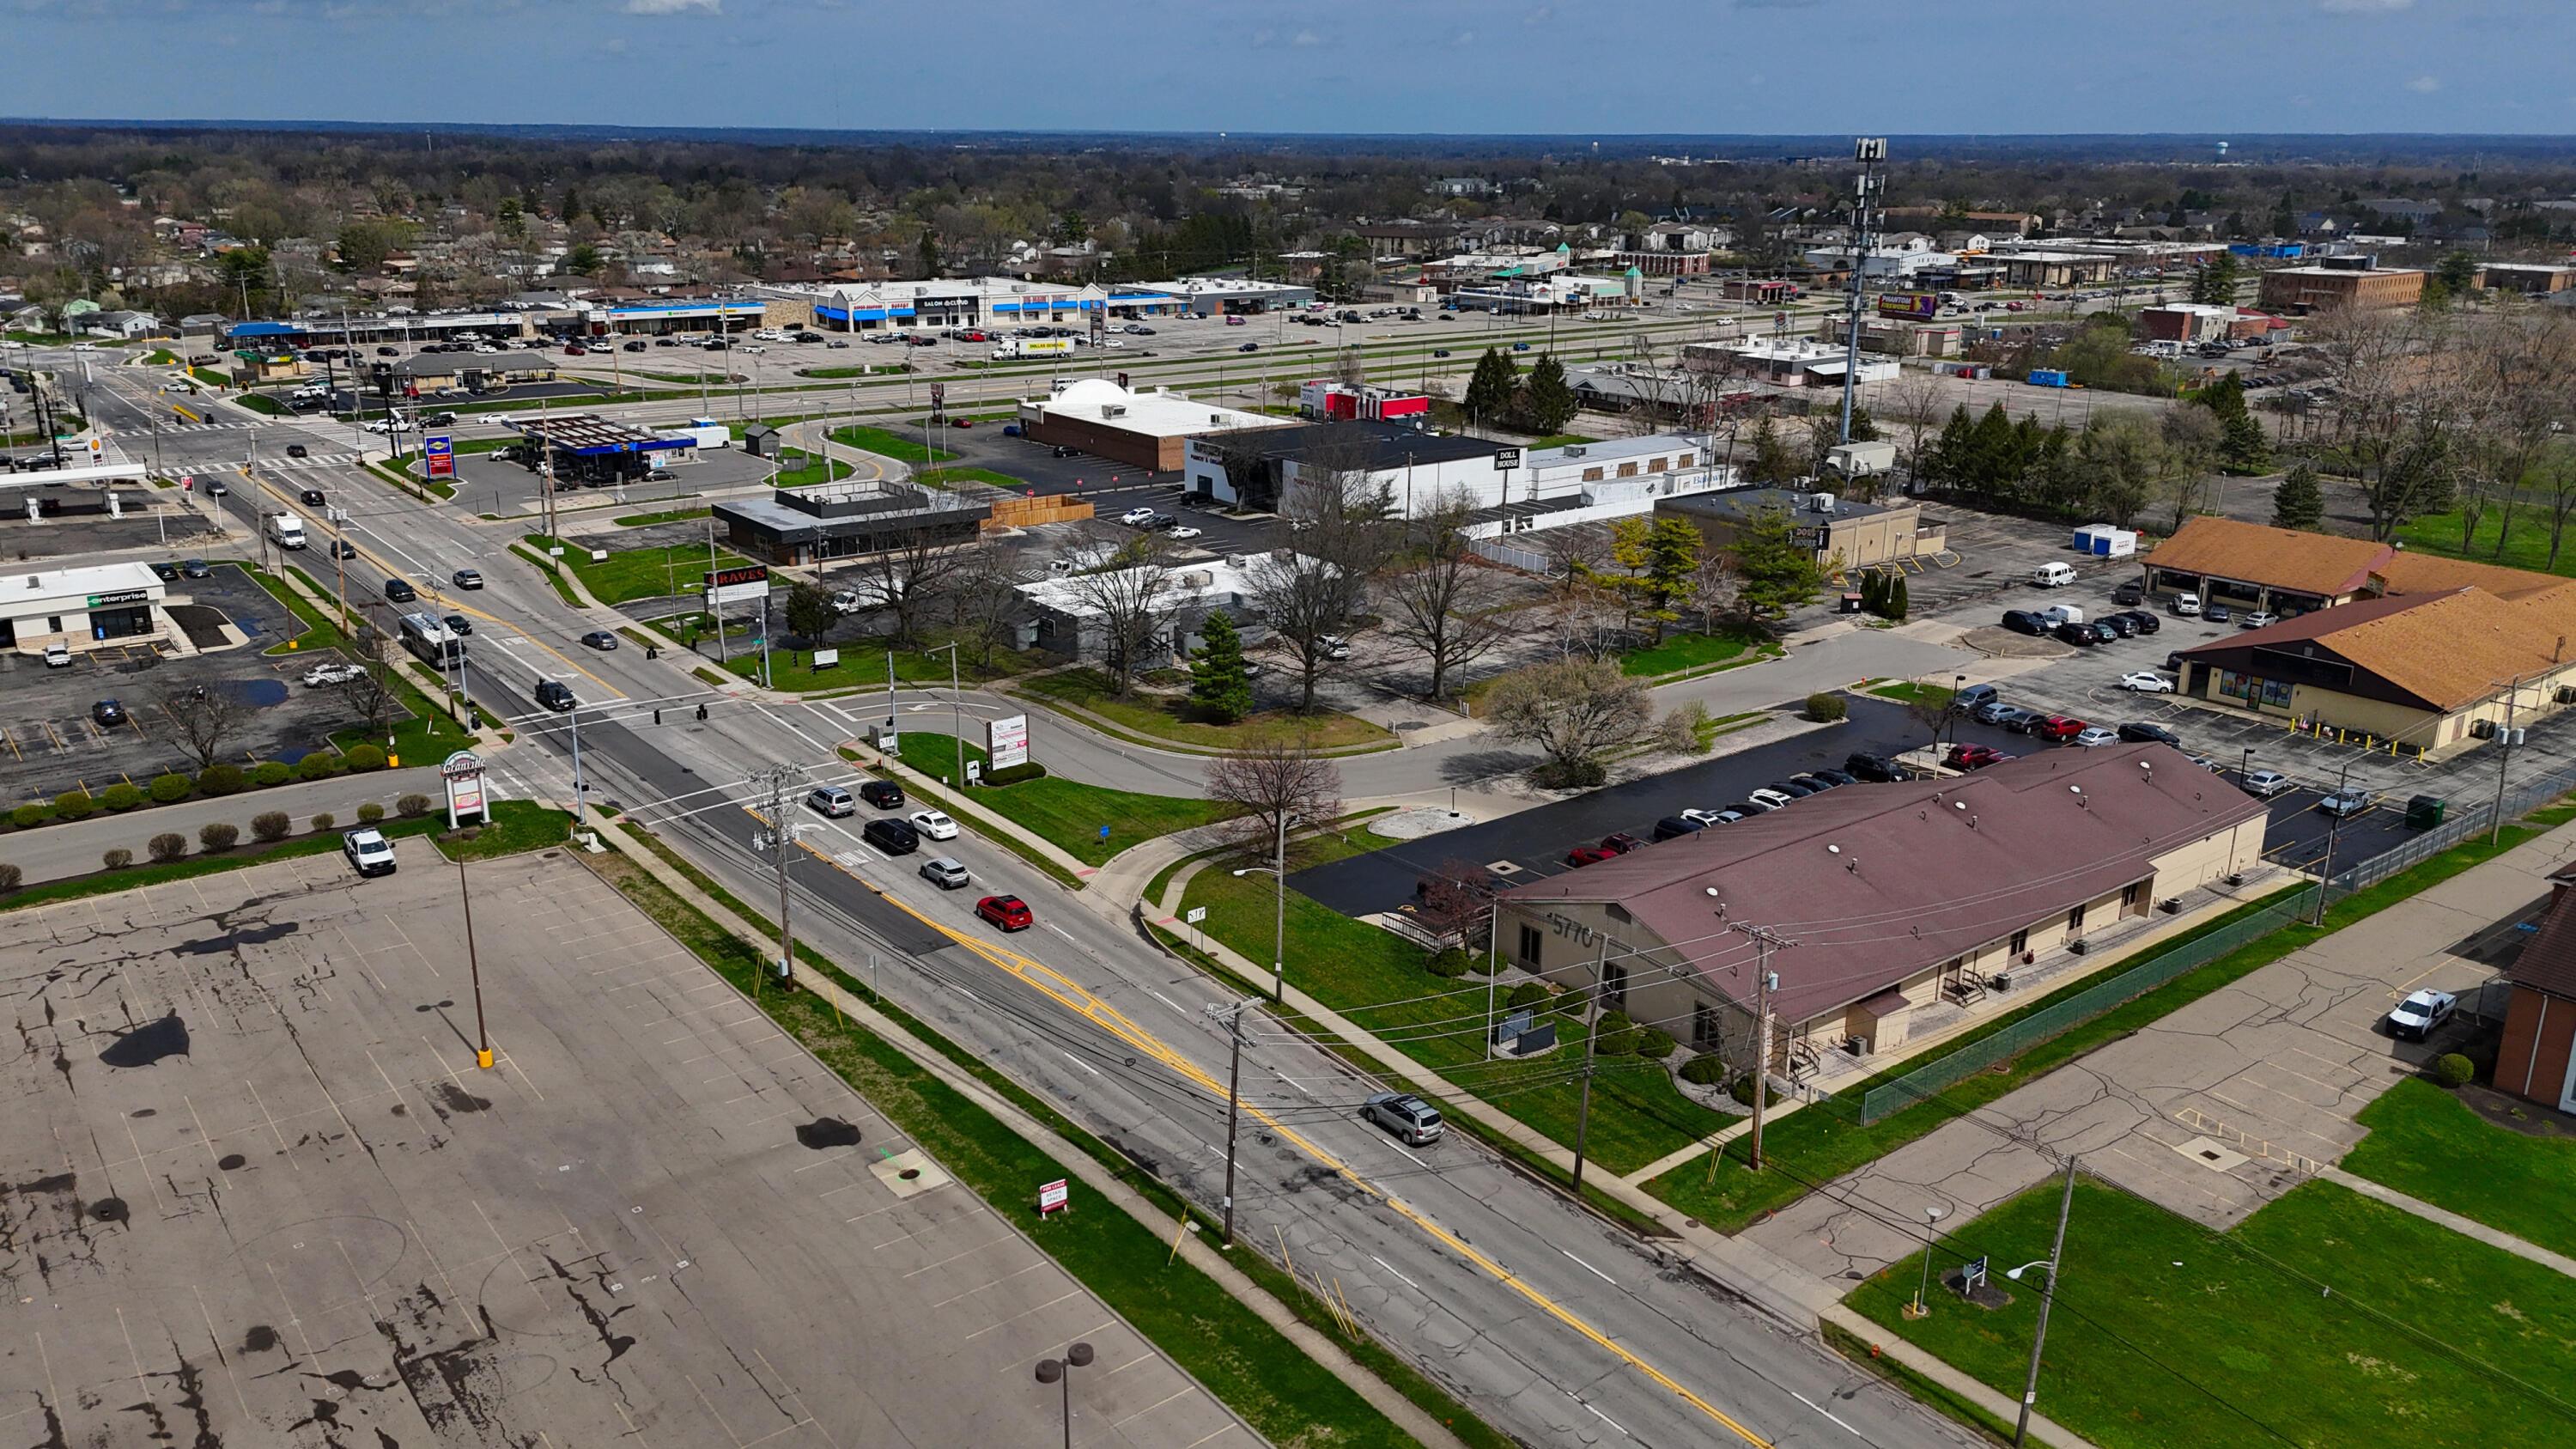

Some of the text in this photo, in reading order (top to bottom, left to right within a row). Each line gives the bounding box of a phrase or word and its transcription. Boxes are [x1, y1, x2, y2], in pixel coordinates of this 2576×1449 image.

[1882, 295, 1911, 304] PHANTOM
[1500, 451, 1516, 460] DOLL
[1497, 459, 1519, 468] HOUSE
[89, 593, 147, 604] enterprise
[443, 756, 486, 773] Granville
[833, 849, 873, 866] ONLY
[1553, 913, 1593, 948] 5770
